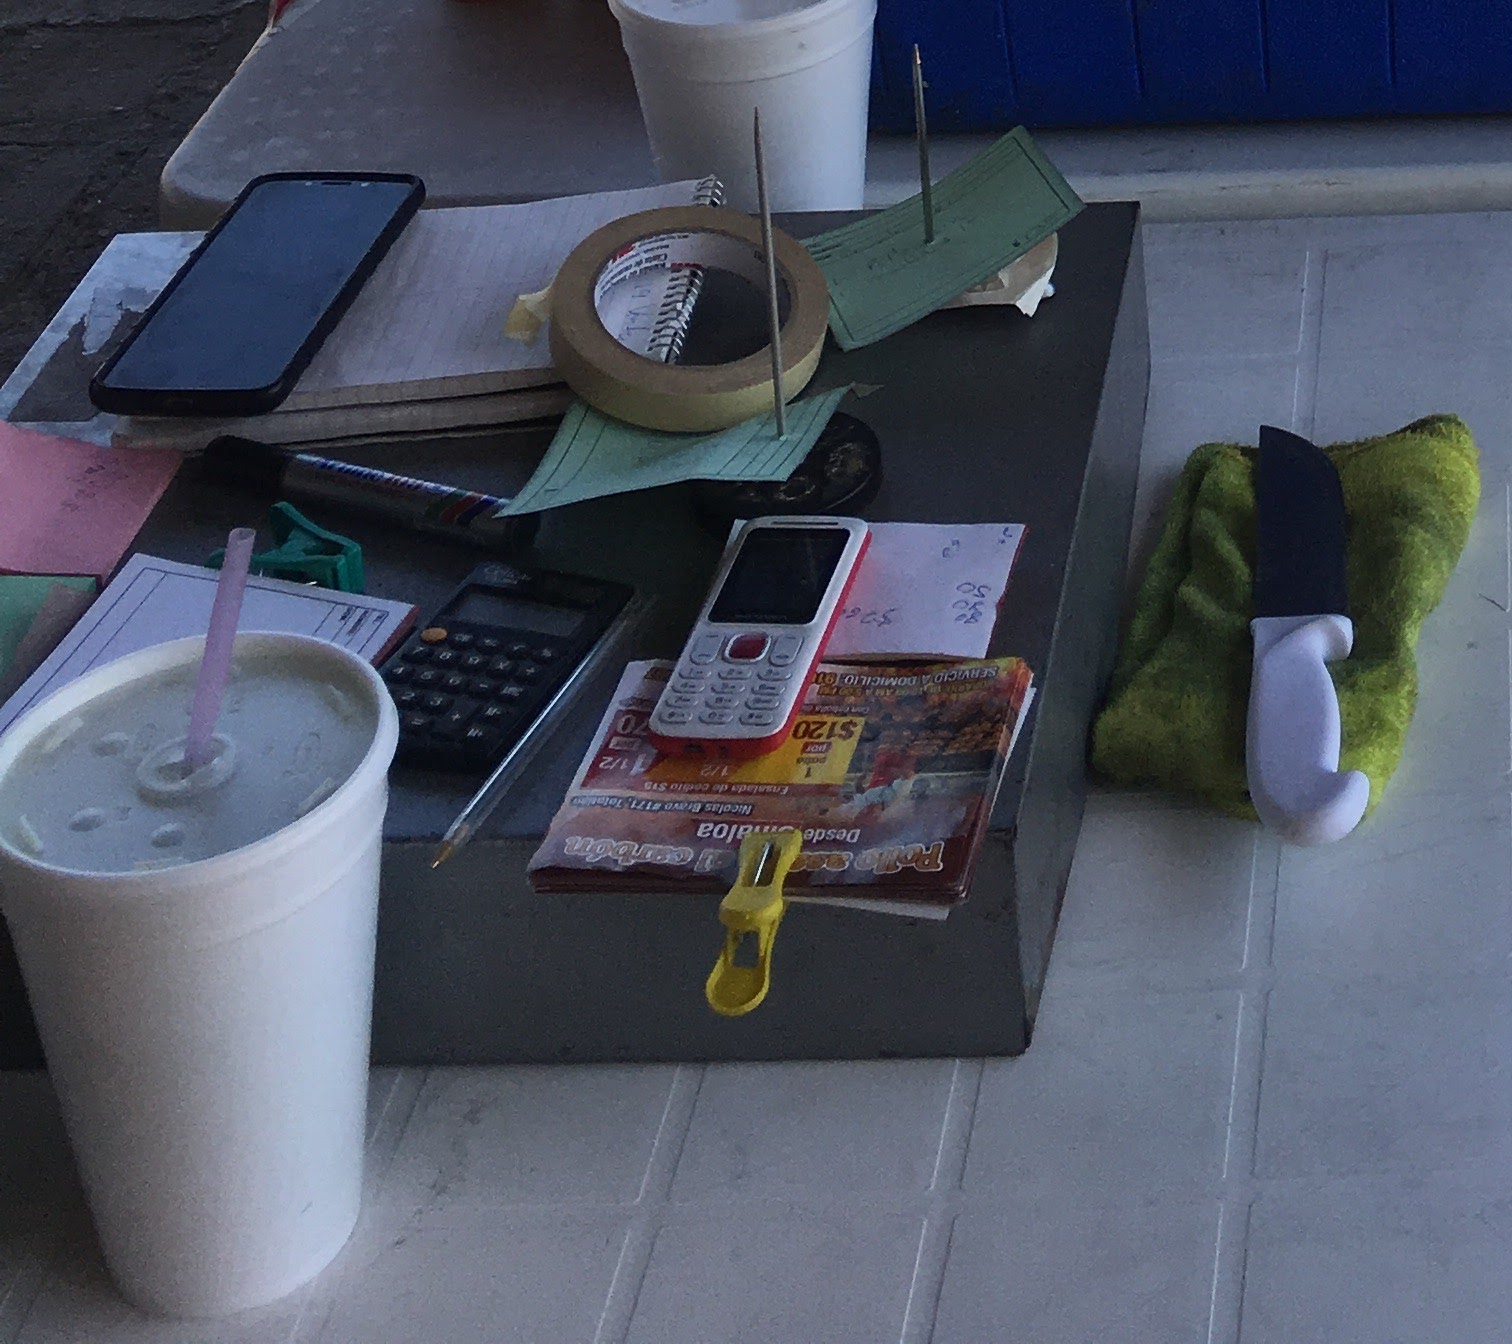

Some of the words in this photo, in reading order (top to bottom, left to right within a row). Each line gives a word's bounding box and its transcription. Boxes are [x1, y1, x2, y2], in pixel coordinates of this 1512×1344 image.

[792, 719, 858, 742] $120
[803, 827, 861, 844] Desde
[854, 841, 945, 873] Pollo
